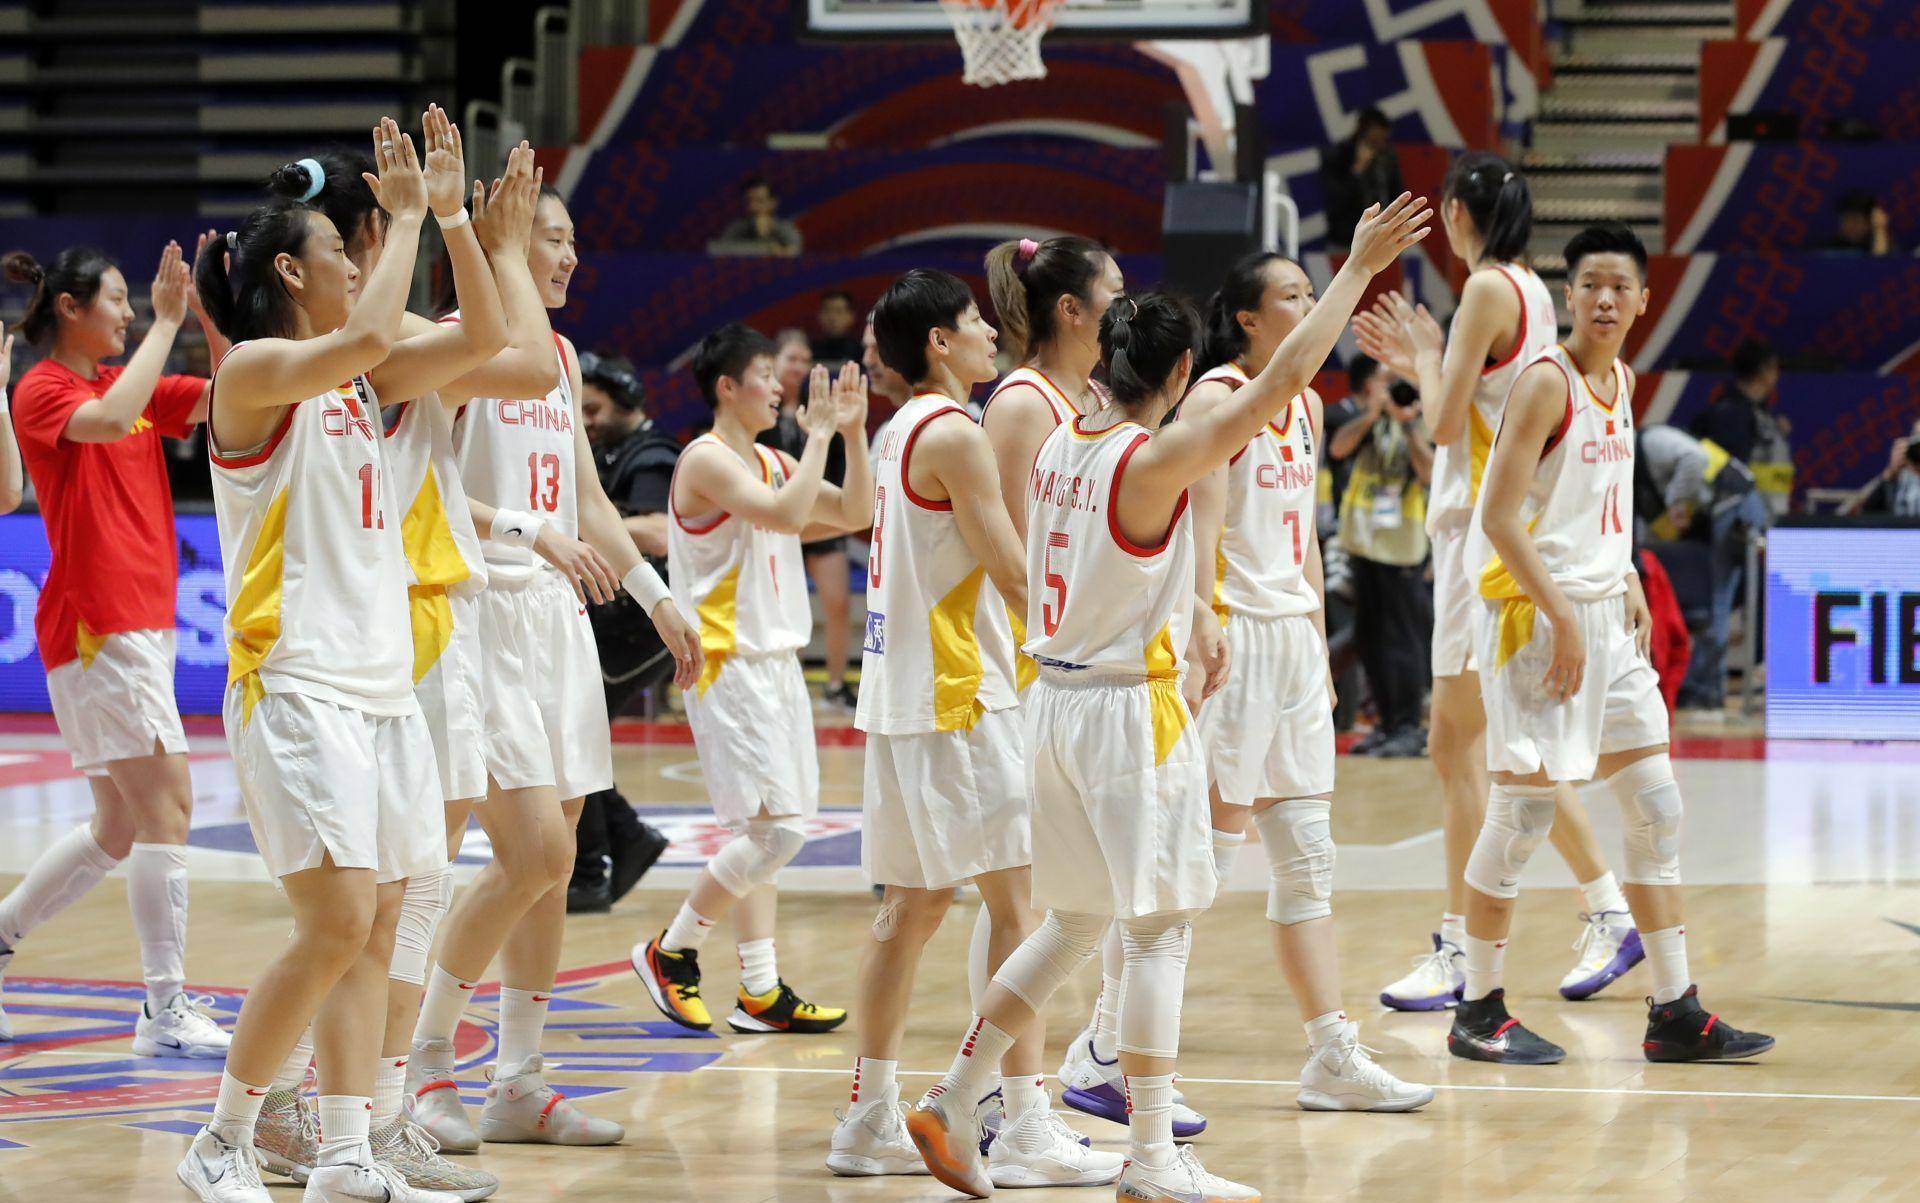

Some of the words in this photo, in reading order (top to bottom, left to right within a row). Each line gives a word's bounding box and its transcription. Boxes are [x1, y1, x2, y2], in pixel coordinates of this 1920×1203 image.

[499, 400, 573, 436] CHINA
[1256, 463, 1314, 490] CHINA
[1581, 439, 1632, 464] CHINA
[359, 463, 384, 529] 1
[528, 452, 560, 512] 13
[1601, 483, 1623, 535] 11
[870, 486, 886, 588] 3
[1283, 511, 1302, 565] 7
[1043, 532, 1070, 638] 5
